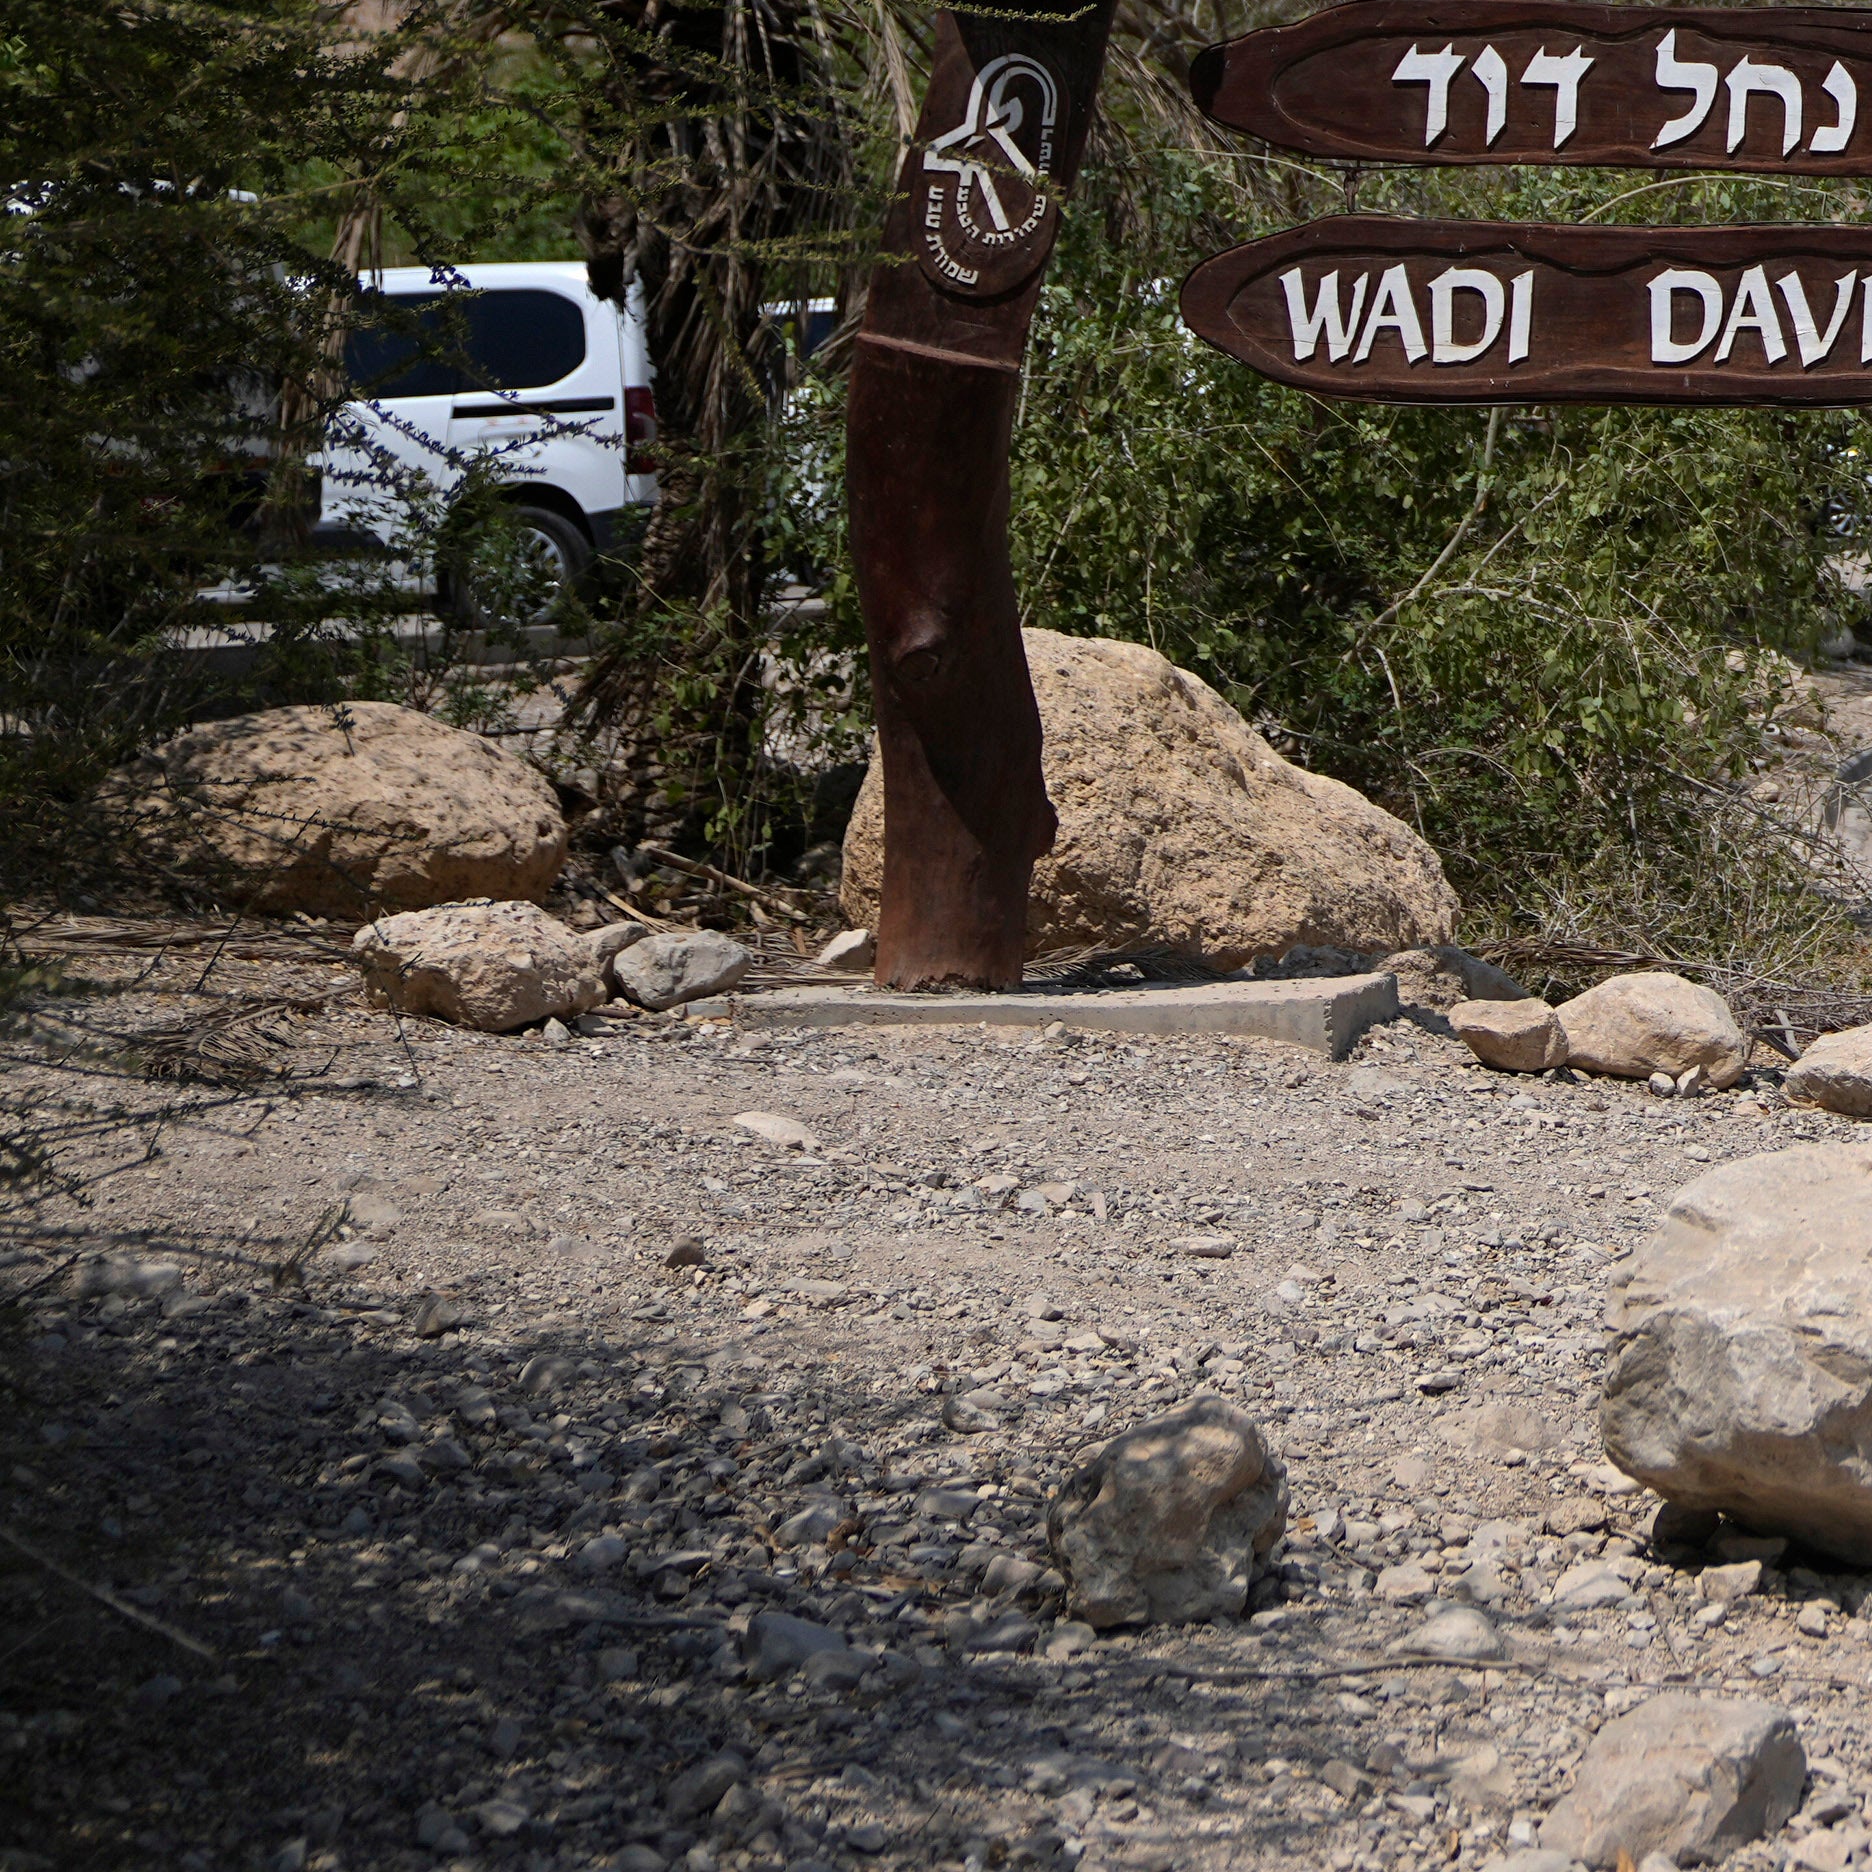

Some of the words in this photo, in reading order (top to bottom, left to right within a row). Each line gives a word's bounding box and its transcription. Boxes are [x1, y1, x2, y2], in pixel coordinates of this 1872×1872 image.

[1391, 42, 1595, 150] דוד
[1651, 26, 1858, 156] נחל
[925, 185, 944, 229] טבע
[956, 186, 981, 239] הטבע
[925, 234, 979, 285] שמורת
[1278, 261, 1535, 367] WADI
